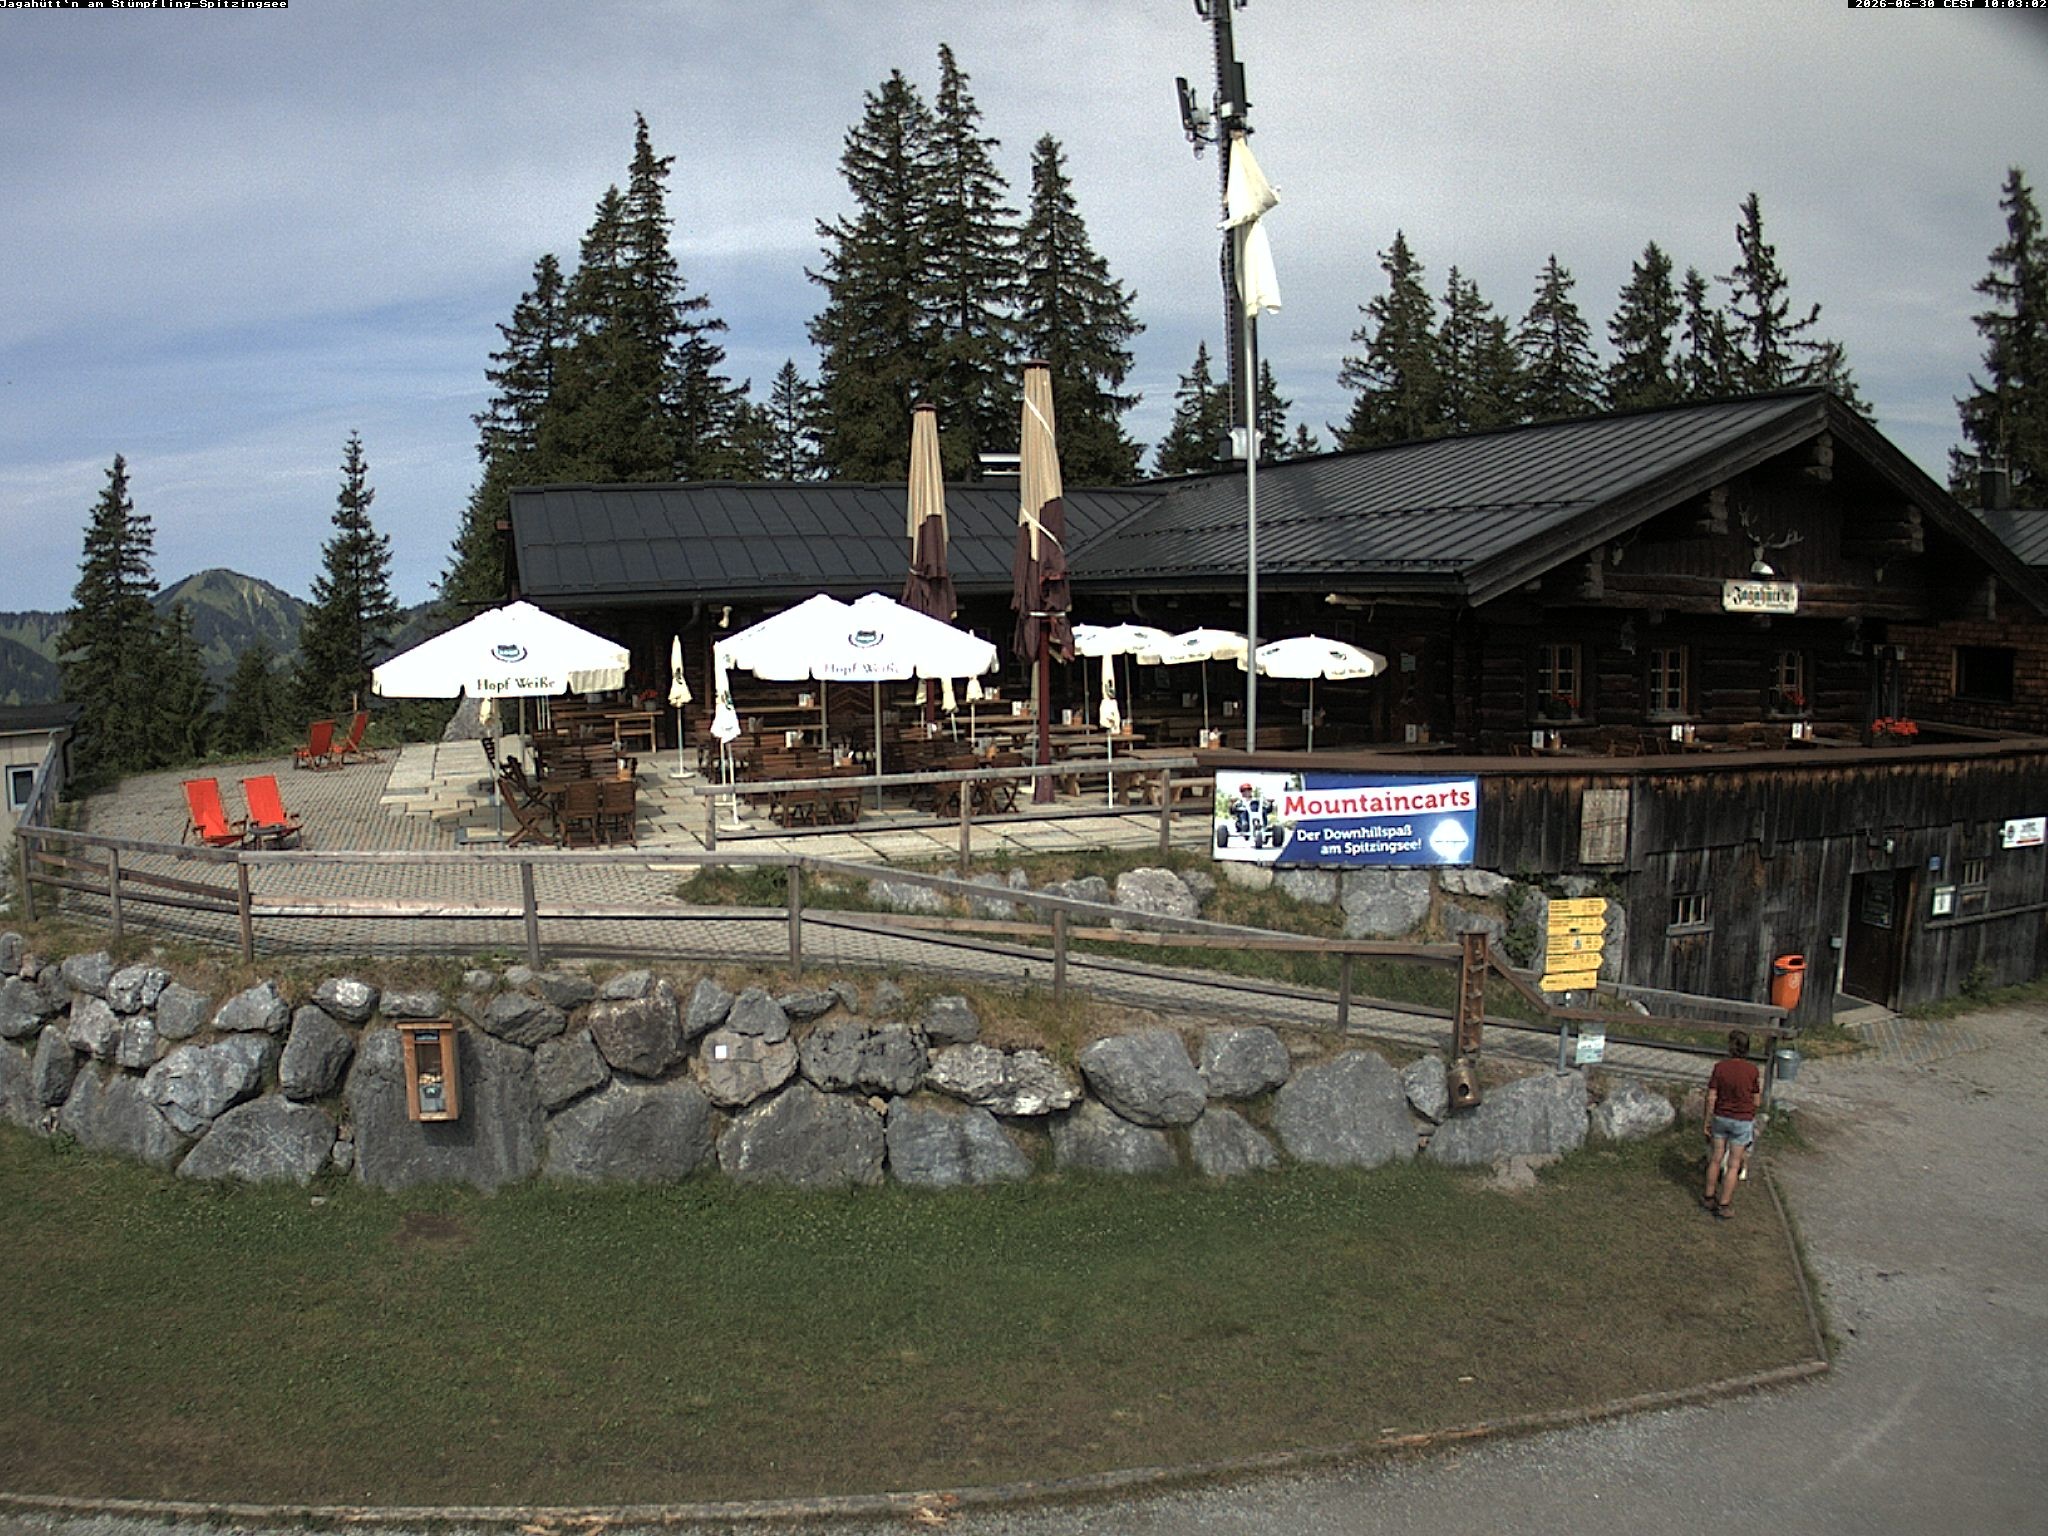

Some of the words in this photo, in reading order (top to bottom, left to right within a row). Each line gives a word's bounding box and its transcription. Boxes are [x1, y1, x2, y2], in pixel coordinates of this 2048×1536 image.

[477, 677, 511, 693] Hopf
[1283, 788, 1471, 817] Mountaincarts
[1296, 829, 1321, 843] Der
[1323, 824, 1413, 841] Downhillspaß
[1320, 844, 1341, 856] am
[1344, 838, 1423, 857] Spitzingsee!
